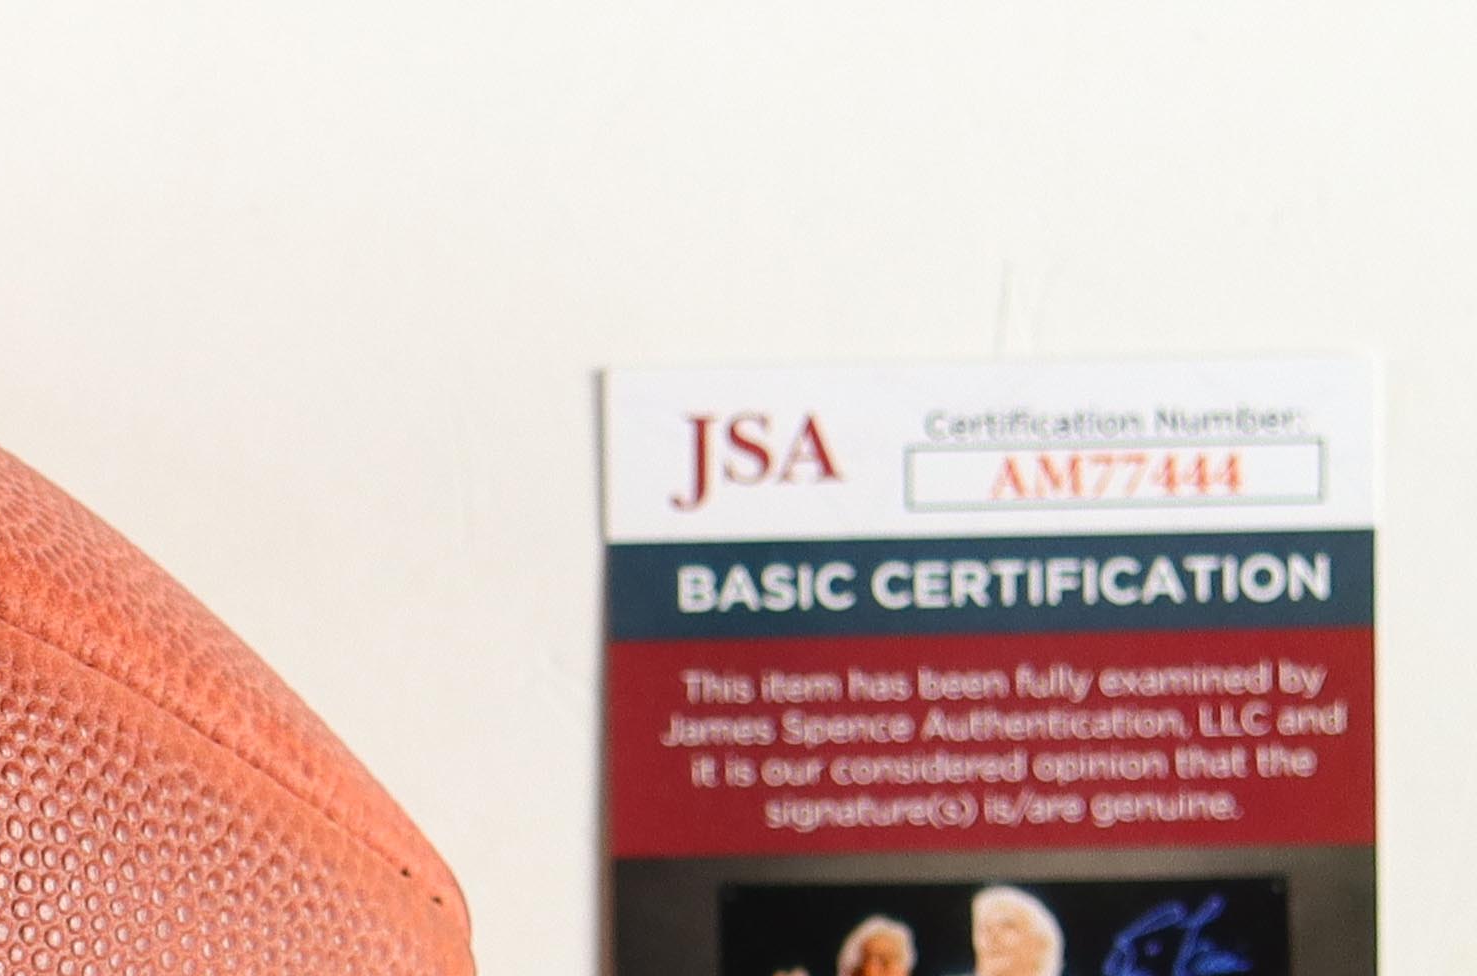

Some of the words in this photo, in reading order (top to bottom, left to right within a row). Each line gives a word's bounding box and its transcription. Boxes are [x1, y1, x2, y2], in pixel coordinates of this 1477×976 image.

[924, 408, 1143, 440] Certification
[670, 408, 843, 512] JSA
[992, 452, 1246, 501] AM77444
[677, 565, 855, 613] BASIC
[871, 553, 1332, 609] CERTIFICATION
[681, 667, 756, 704] This
[760, 668, 843, 703] item
[848, 666, 913, 702] has
[917, 664, 1010, 701] been
[1015, 662, 1093, 704] fully
[1098, 656, 1273, 698] examined
[1278, 657, 1328, 699] by
[660, 711, 777, 747] James
[781, 708, 915, 750] Spence
[921, 704, 1192, 742] Authentication,
[1198, 701, 1273, 738] LLC
[1276, 699, 1348, 737] and
[725, 752, 757, 788] is
[760, 755, 825, 787] our
[829, 748, 1027, 785] considered
[1032, 744, 1169, 785] opinion
[1174, 744, 1249, 779] that
[1255, 742, 1318, 778] the
[764, 790, 979, 833] signature(s)
[984, 784, 1087, 828] is/are
[1090, 788, 1244, 829] genuine.
